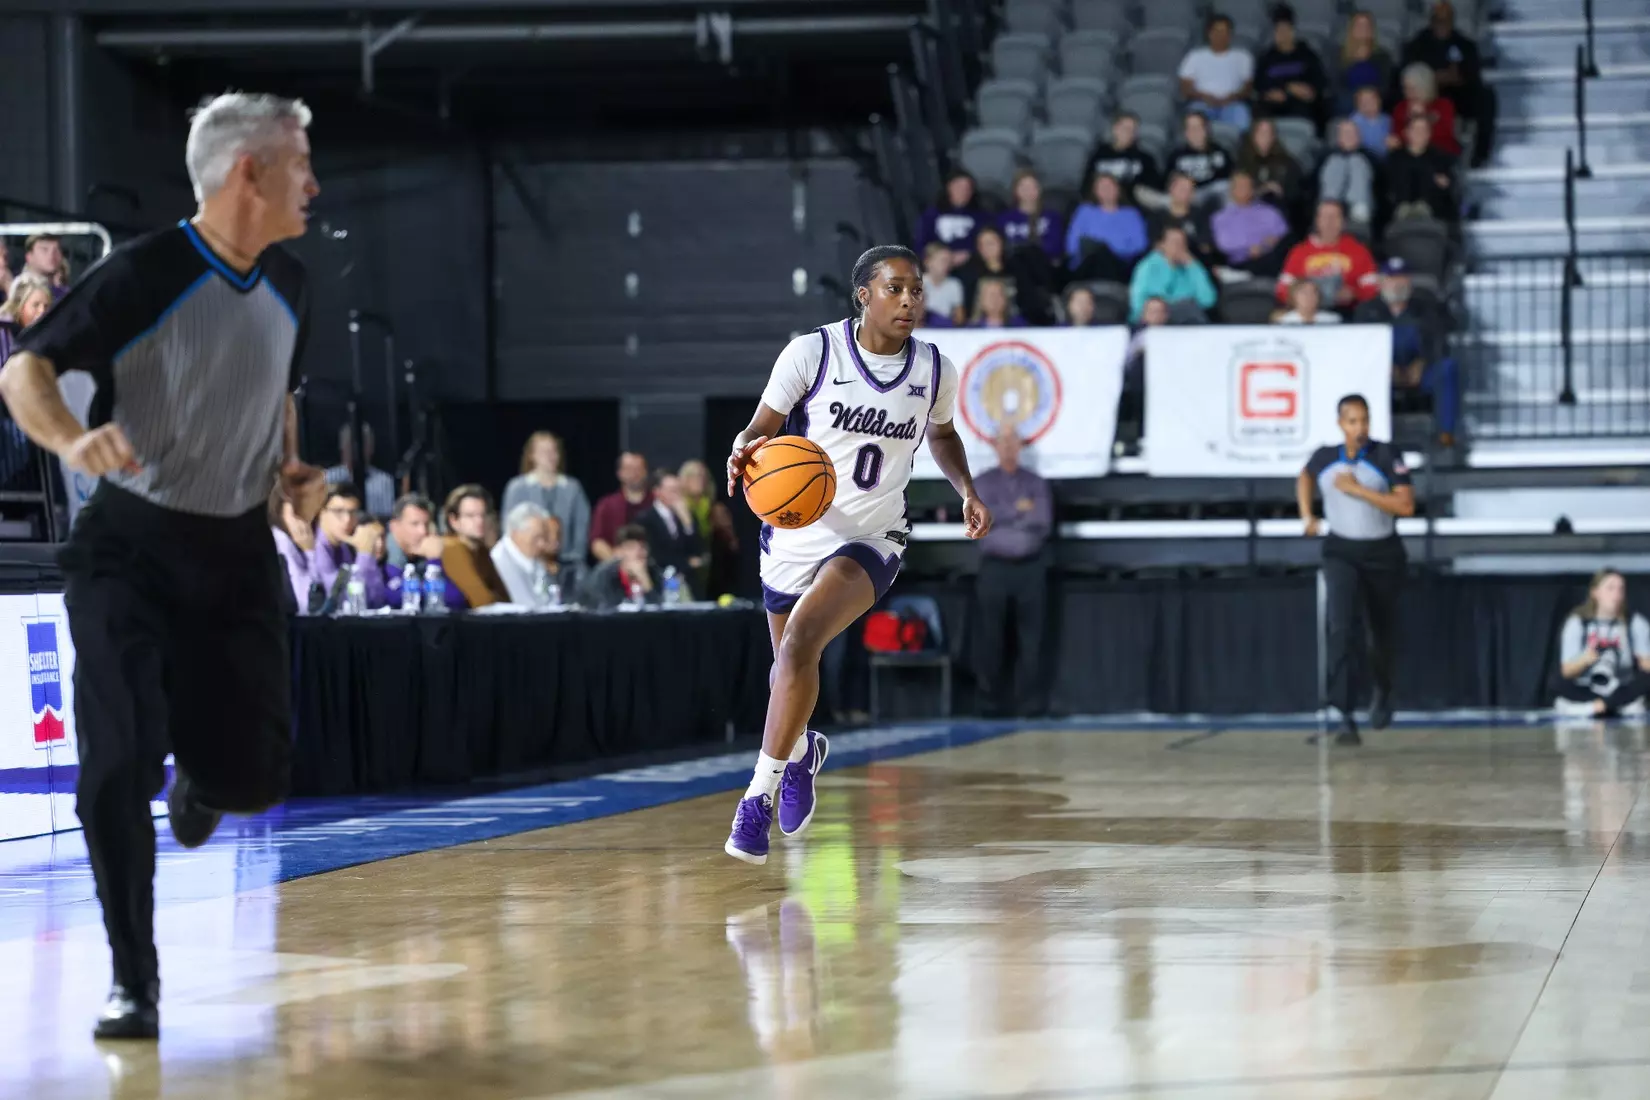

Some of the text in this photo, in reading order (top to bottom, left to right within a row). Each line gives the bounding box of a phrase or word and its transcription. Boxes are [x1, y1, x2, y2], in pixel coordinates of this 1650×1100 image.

[907, 384, 927, 399] XII
[1240, 362, 1297, 419] G
[829, 401, 918, 440] Wildcats
[852, 442, 884, 492] 0
[29, 651, 59, 671] SHELTER
